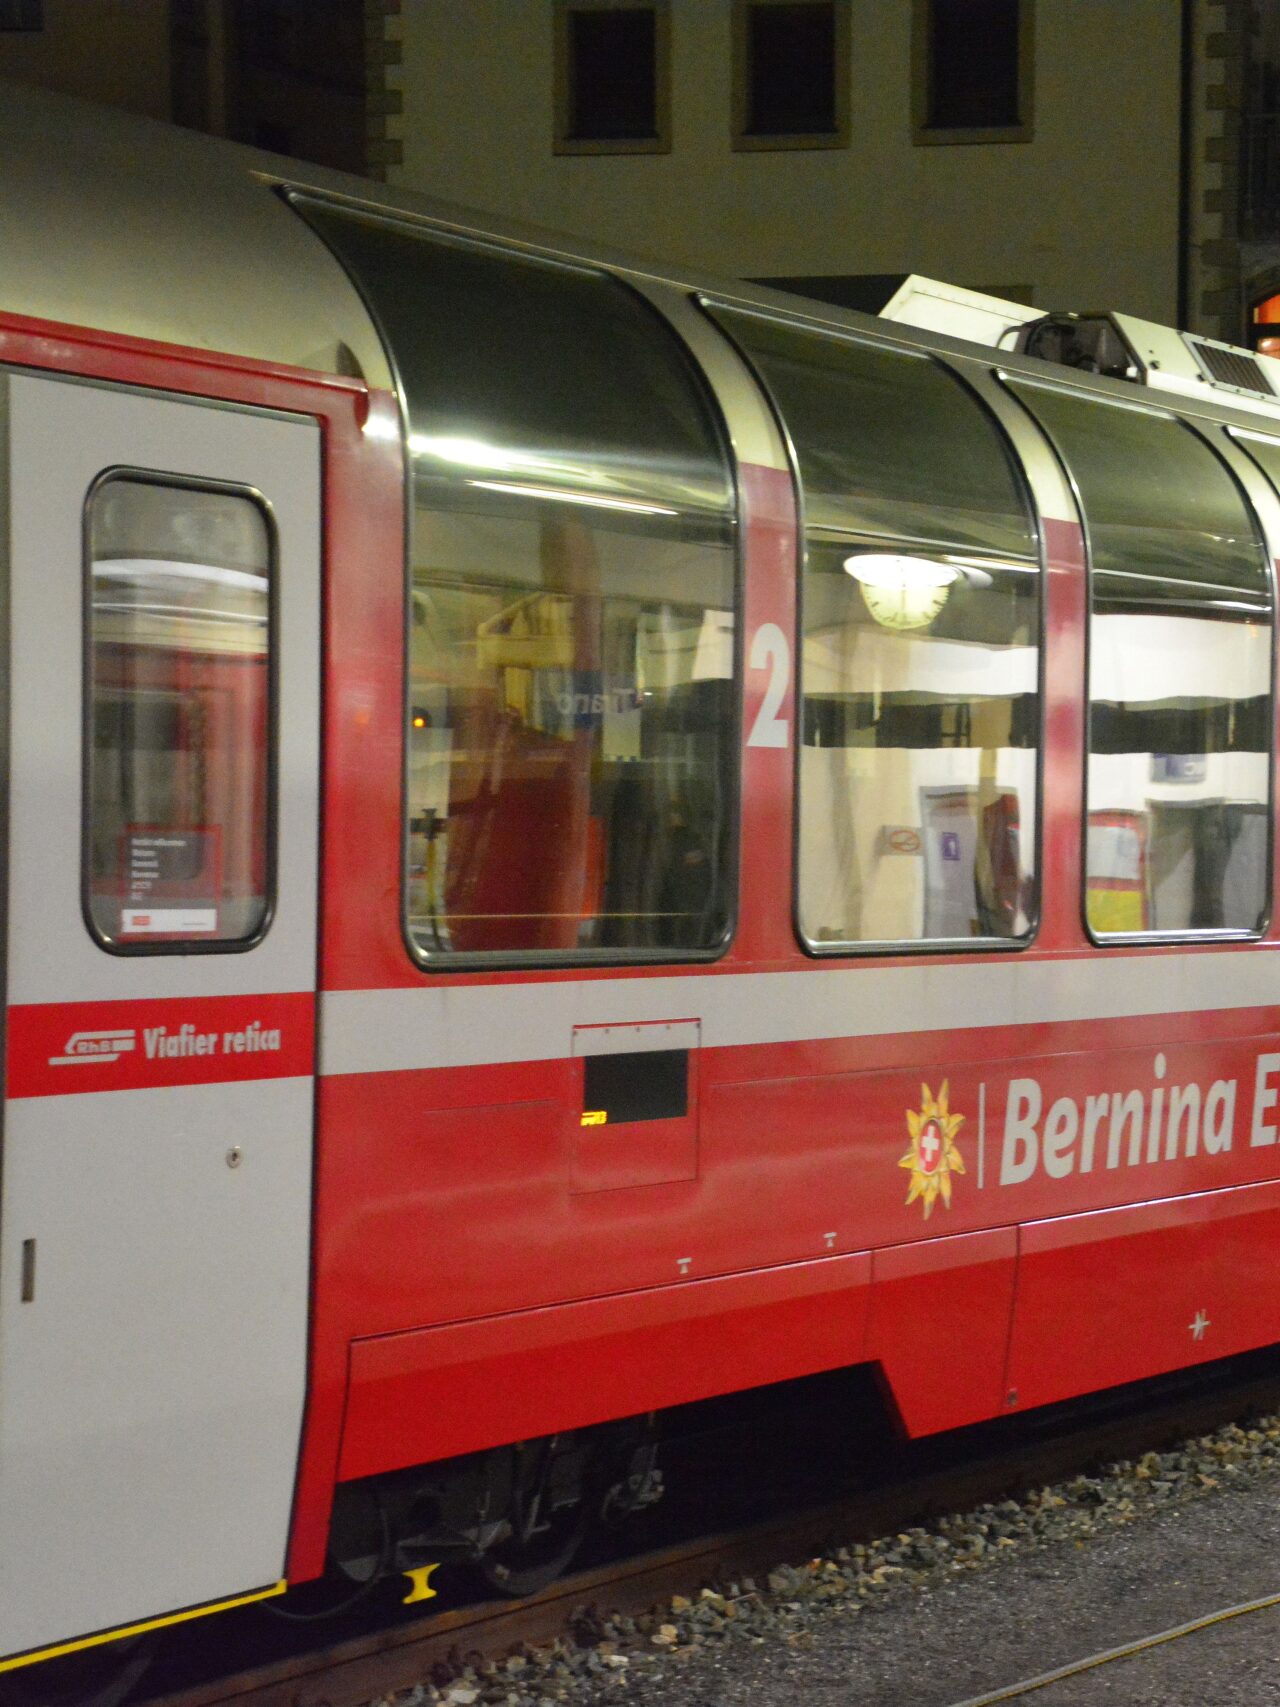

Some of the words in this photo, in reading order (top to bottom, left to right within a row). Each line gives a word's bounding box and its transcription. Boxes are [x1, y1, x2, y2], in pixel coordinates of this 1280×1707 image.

[746, 622, 790, 748] 2
[143, 1024, 218, 1060] Viafier
[223, 1020, 282, 1055] retica
[1000, 1052, 1238, 1186] Bernina
